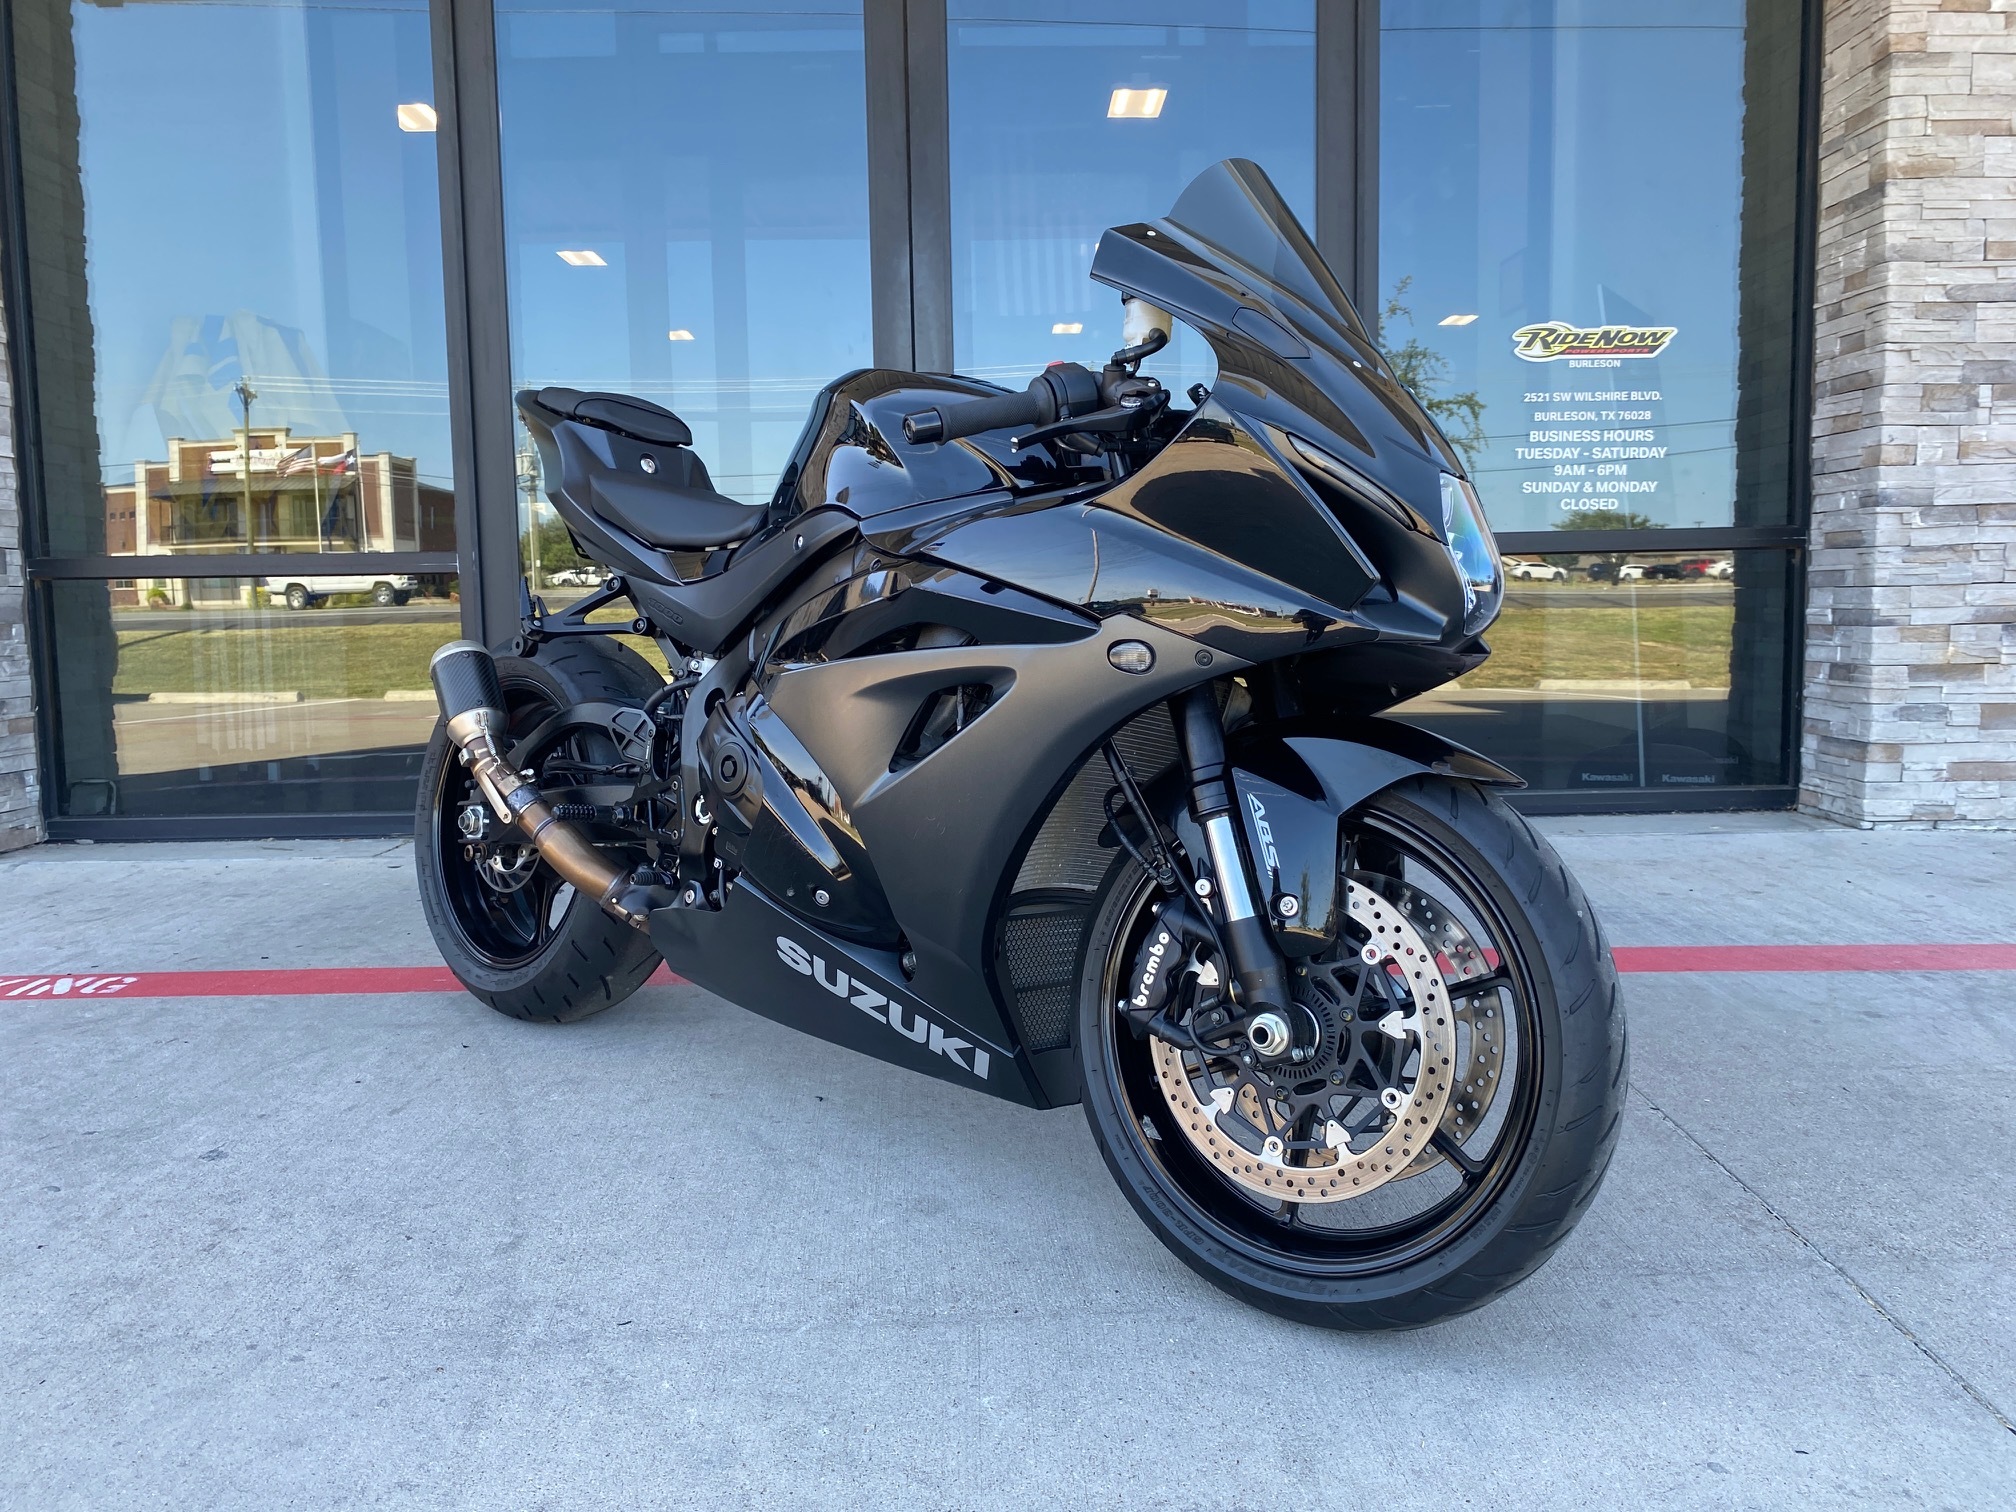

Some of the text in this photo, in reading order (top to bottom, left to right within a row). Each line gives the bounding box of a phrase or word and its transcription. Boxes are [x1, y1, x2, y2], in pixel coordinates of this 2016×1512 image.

[1568, 359, 1621, 368] BURLESON
[1523, 391, 1663, 403] 2521 SW WILSHIRE BLVD.
[1534, 410, 1652, 422] BURLESON, TX 76028
[1529, 430, 1654, 442] BUSINESS HOURS
[1515, 447, 1580, 460] TUESDAY
[1592, 447, 1668, 459] SATURDAY
[1554, 465, 1585, 476] 9AM
[1597, 464, 1627, 476] 6PM
[1522, 481, 1658, 494] SUNDAY & MONDAY
[1560, 498, 1619, 511] CLOSED
[1582, 773, 1634, 782] Kawasaki
[1662, 774, 1716, 784] Kawasaki
[1248, 793, 1281, 872] ABS
[1132, 932, 1170, 1007] brembo
[776, 936, 990, 1081] SUZUKI
